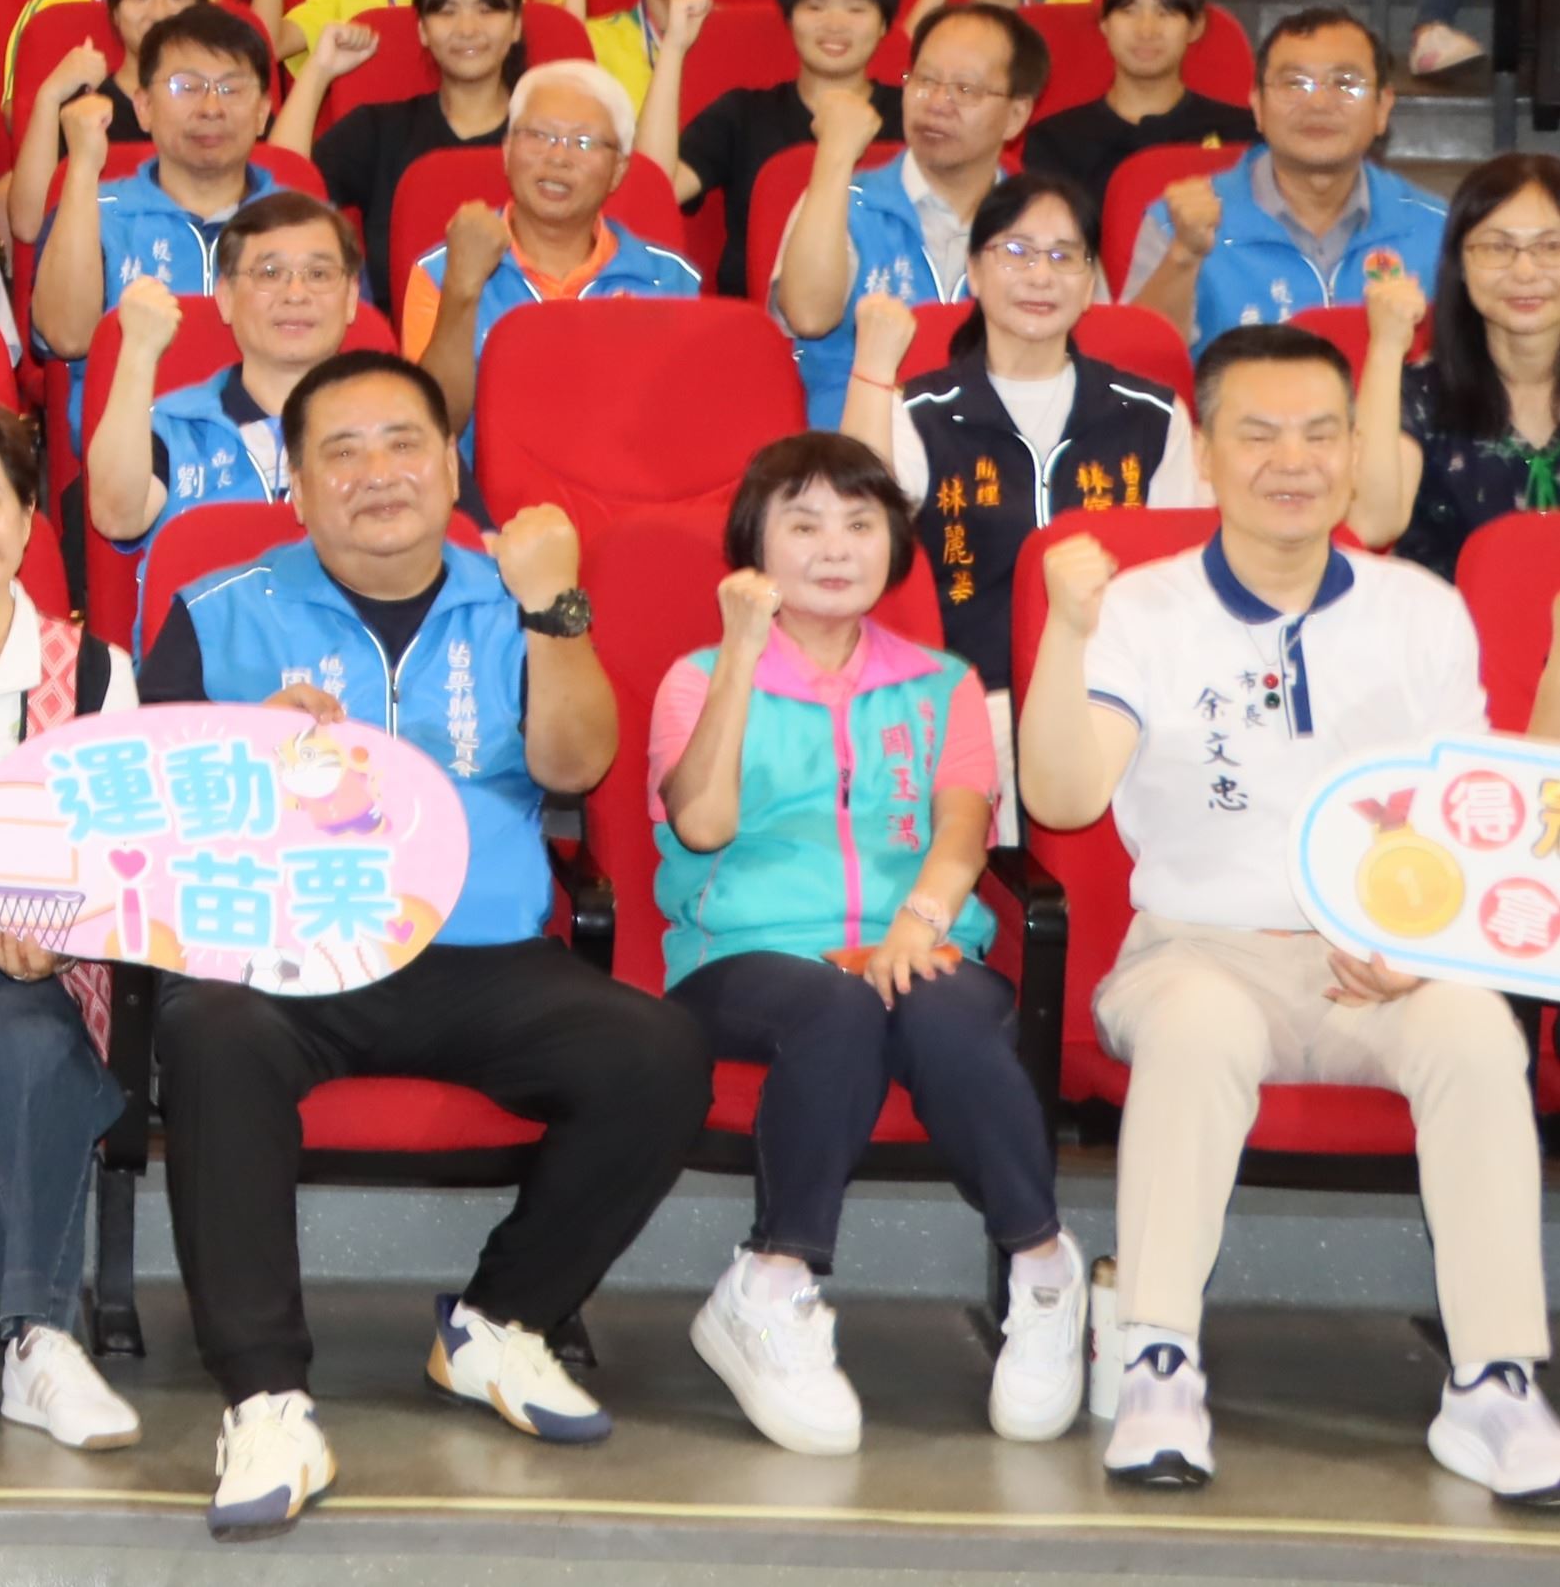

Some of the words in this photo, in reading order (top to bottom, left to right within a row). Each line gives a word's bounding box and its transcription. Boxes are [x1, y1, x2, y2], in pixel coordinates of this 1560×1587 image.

[175, 462, 207, 499] 劉
[1235, 670, 1268, 729] 市長
[45, 737, 281, 844] 運動
[1193, 686, 1249, 812] 余文忠
